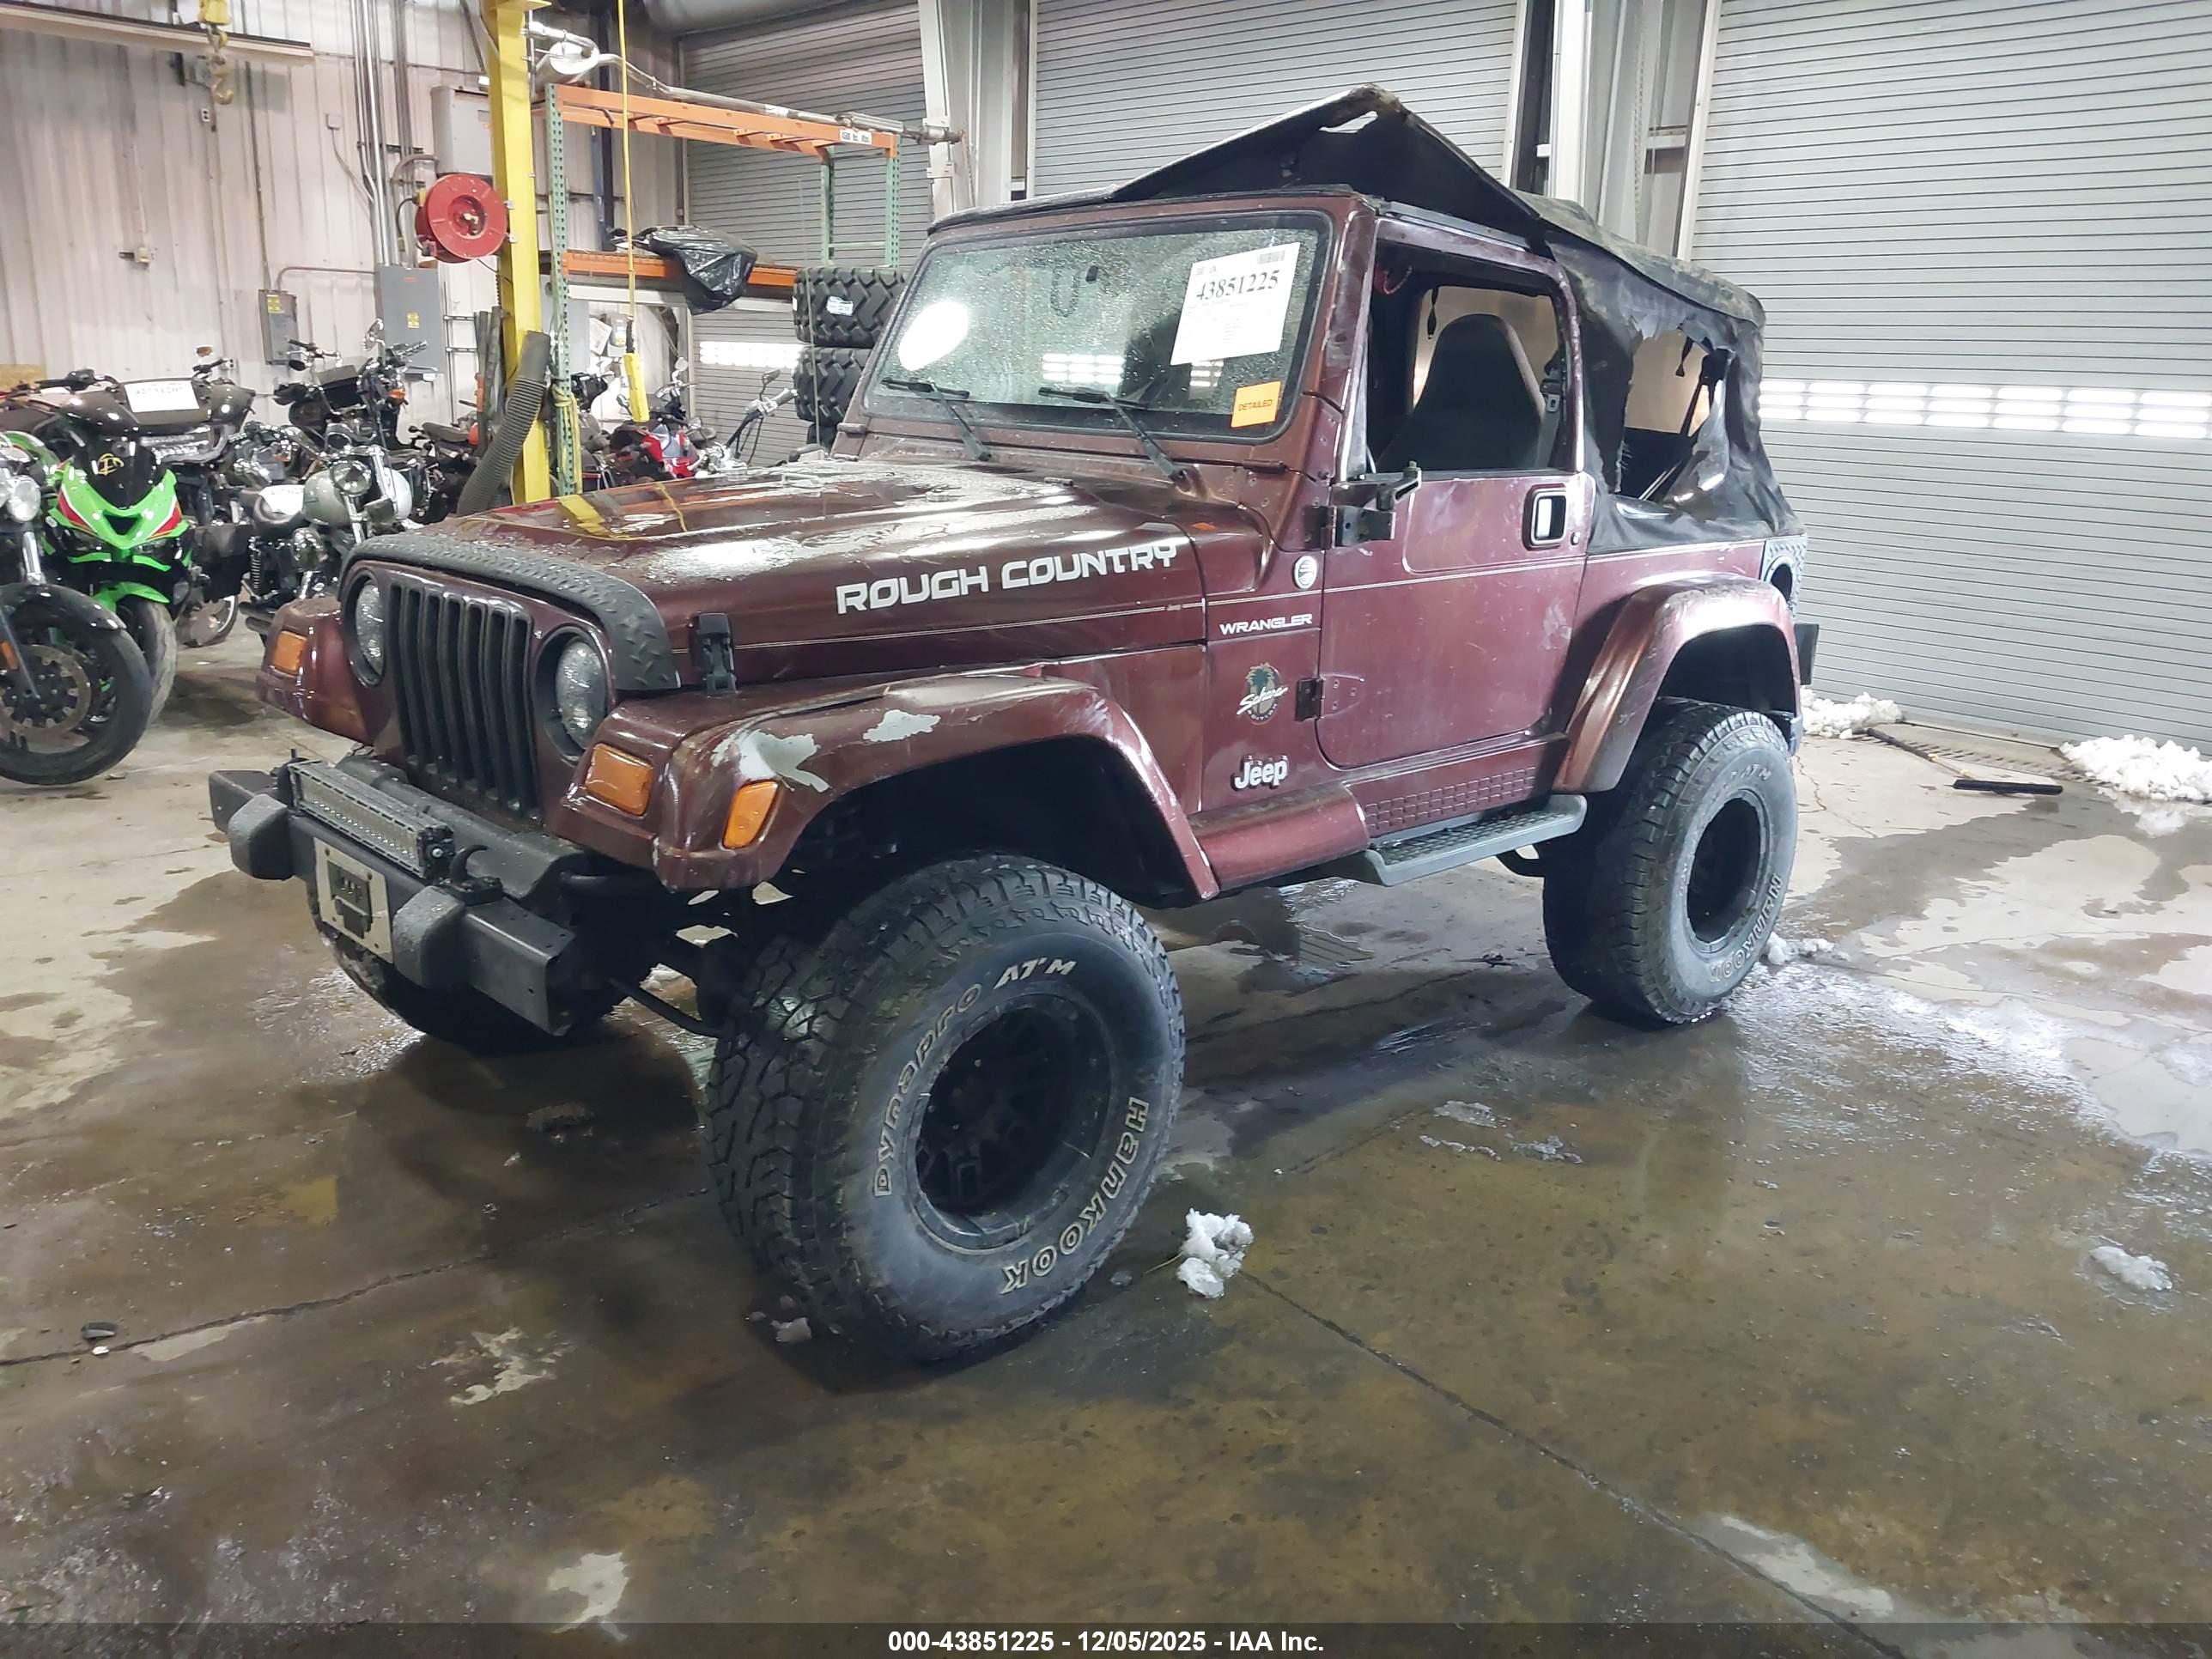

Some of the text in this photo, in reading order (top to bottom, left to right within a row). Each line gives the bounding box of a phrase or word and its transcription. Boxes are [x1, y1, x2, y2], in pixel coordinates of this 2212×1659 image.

[1196, 269, 1279, 301] 43851225
[1237, 398, 1273, 411] DETAILED
[836, 542, 1177, 615] ROUGH COUNTRY
[1219, 613, 1313, 635] WRANGLER
[1234, 757, 1288, 789] Jeep
